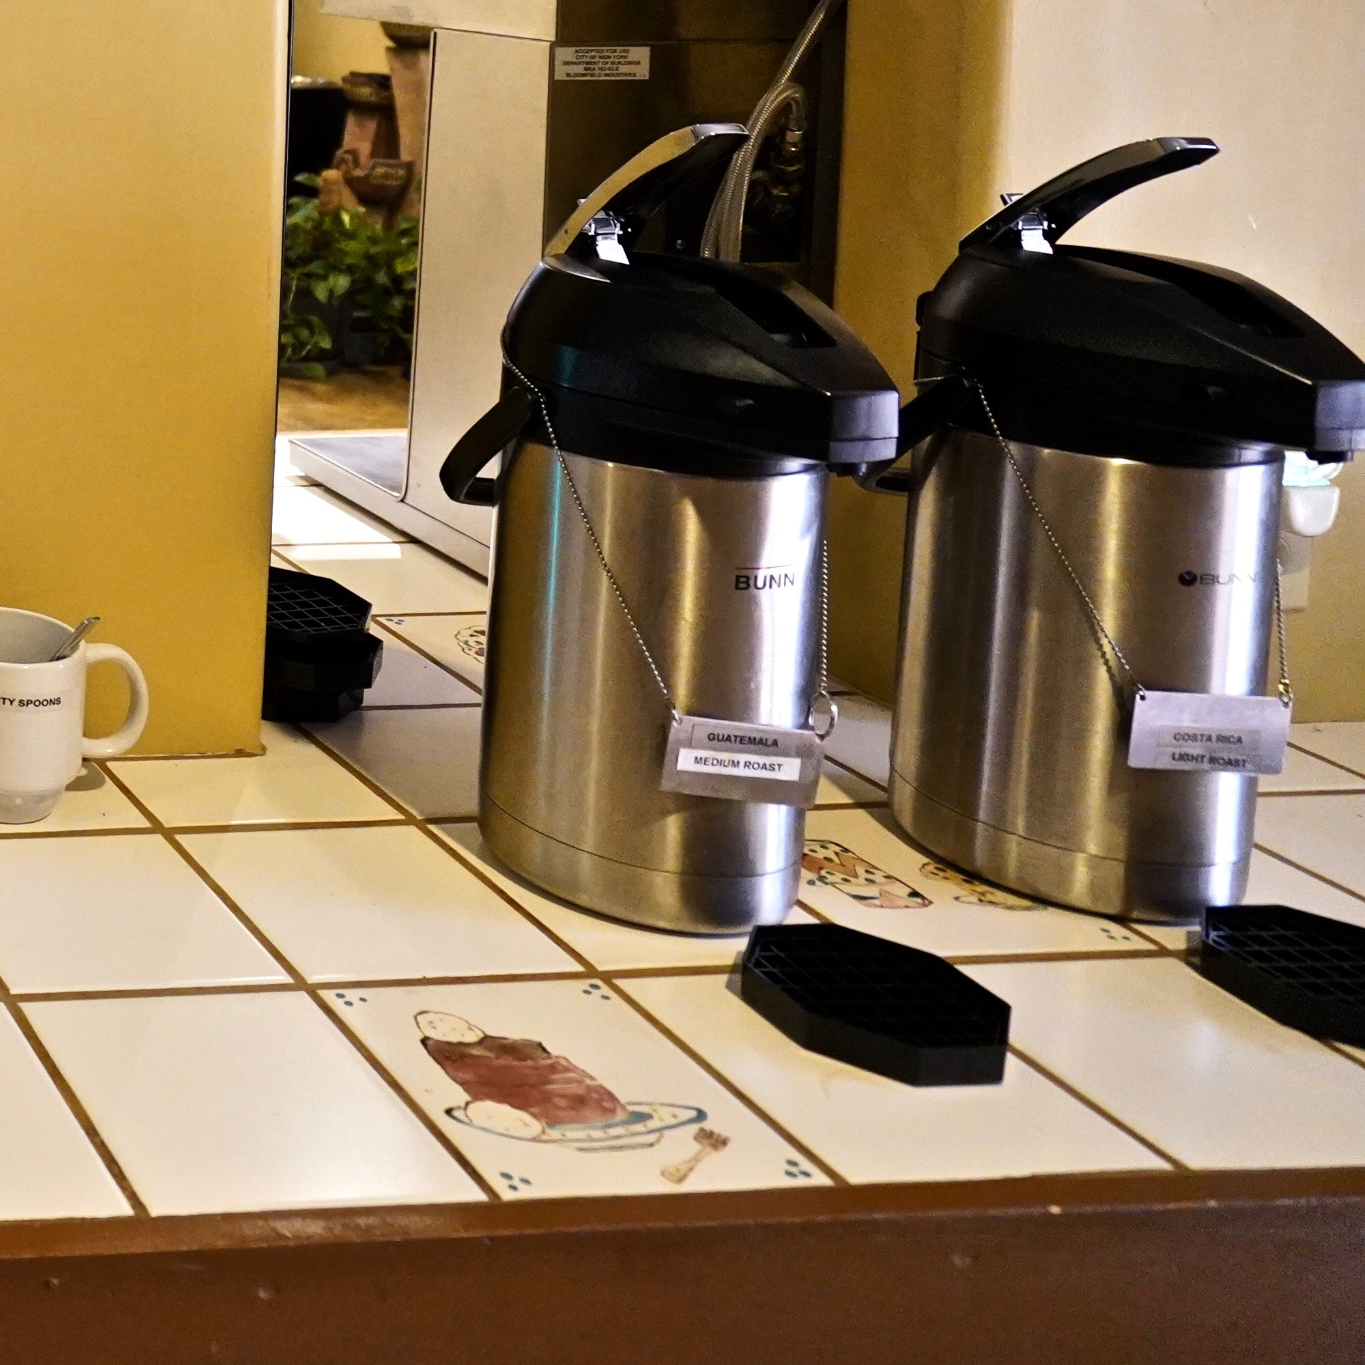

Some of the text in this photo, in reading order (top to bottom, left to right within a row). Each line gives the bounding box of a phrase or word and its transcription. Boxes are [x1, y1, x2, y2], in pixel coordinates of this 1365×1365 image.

[734, 573, 795, 590] BUNN
[18, 697, 62, 708] SPOONS
[707, 732, 779, 748] GUATEMALA
[1173, 732, 1213, 743] COSTA
[694, 756, 784, 773] MEDIUM ROAST
[1171, 751, 1248, 768] LIGHT ROAST
